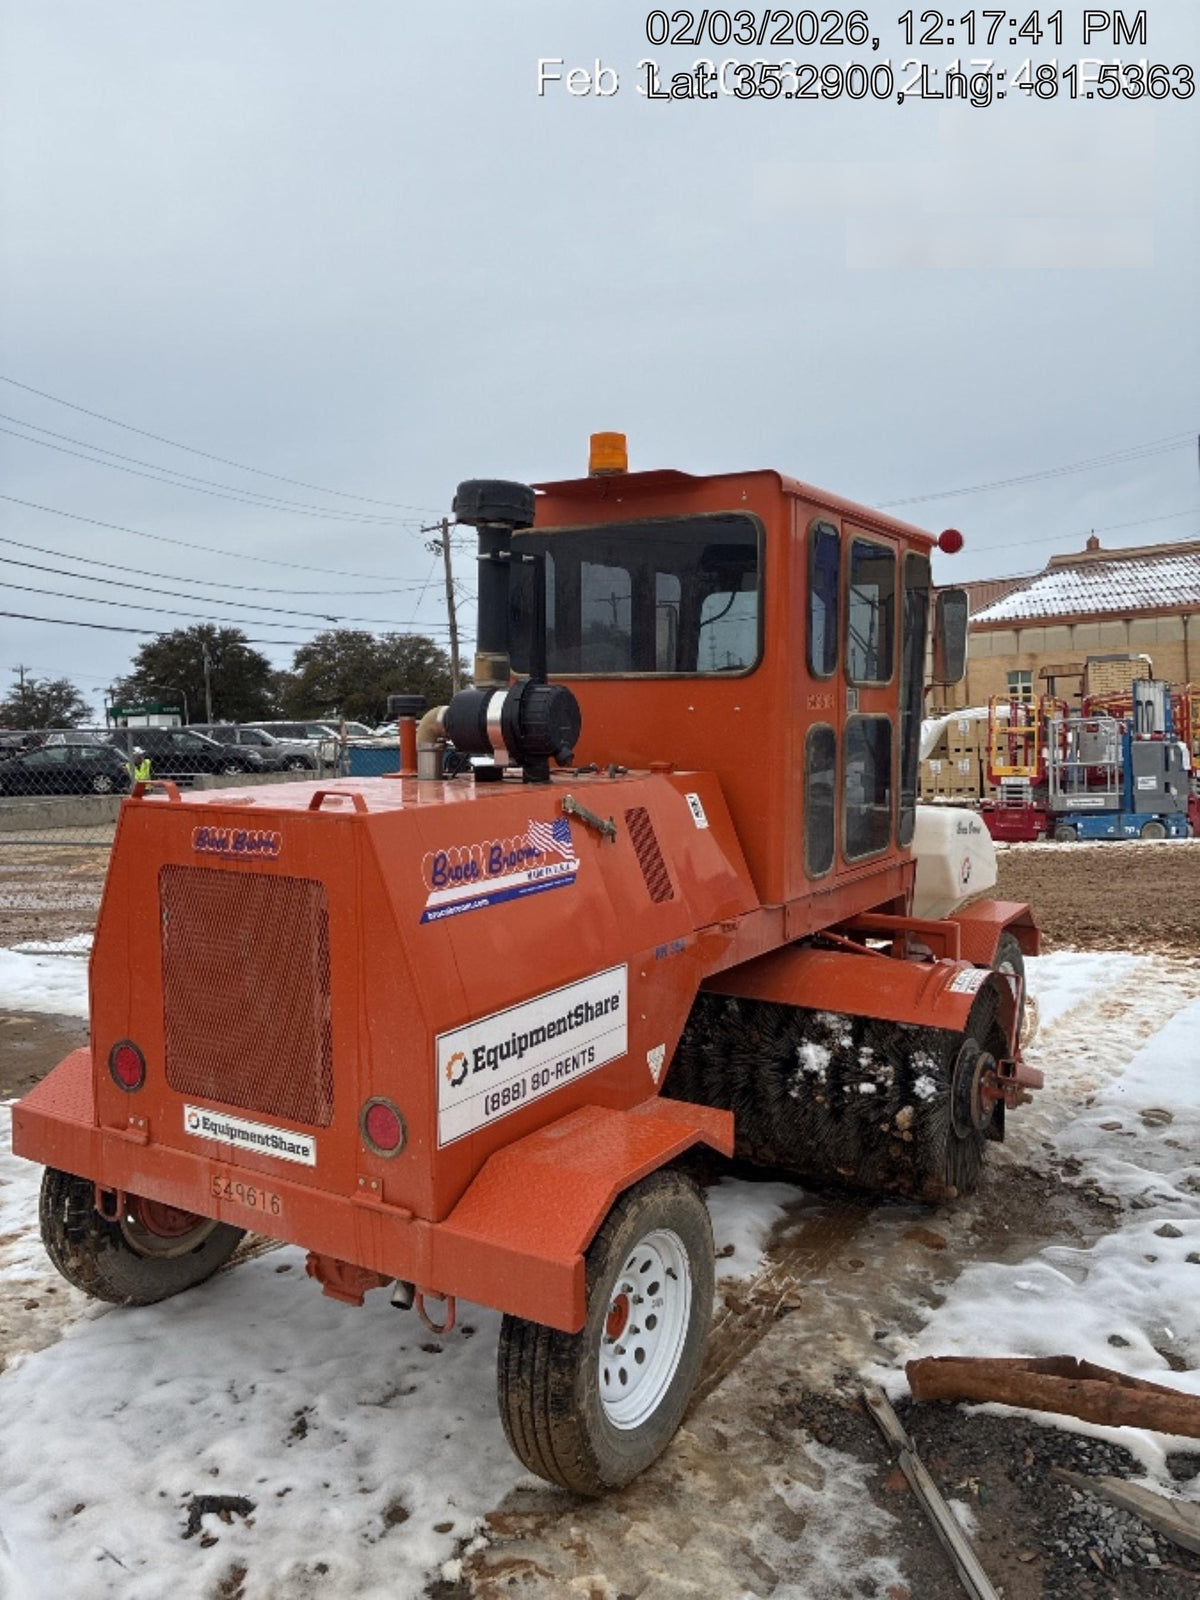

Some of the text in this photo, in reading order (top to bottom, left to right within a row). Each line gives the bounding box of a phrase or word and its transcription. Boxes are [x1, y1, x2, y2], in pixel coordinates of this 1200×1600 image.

[472, 994, 620, 1074] EquipmentShare
[484, 1078, 527, 1115] (888)
[202, 1116, 311, 1157] EquipmentShare
[212, 1176, 282, 1216] 549616
